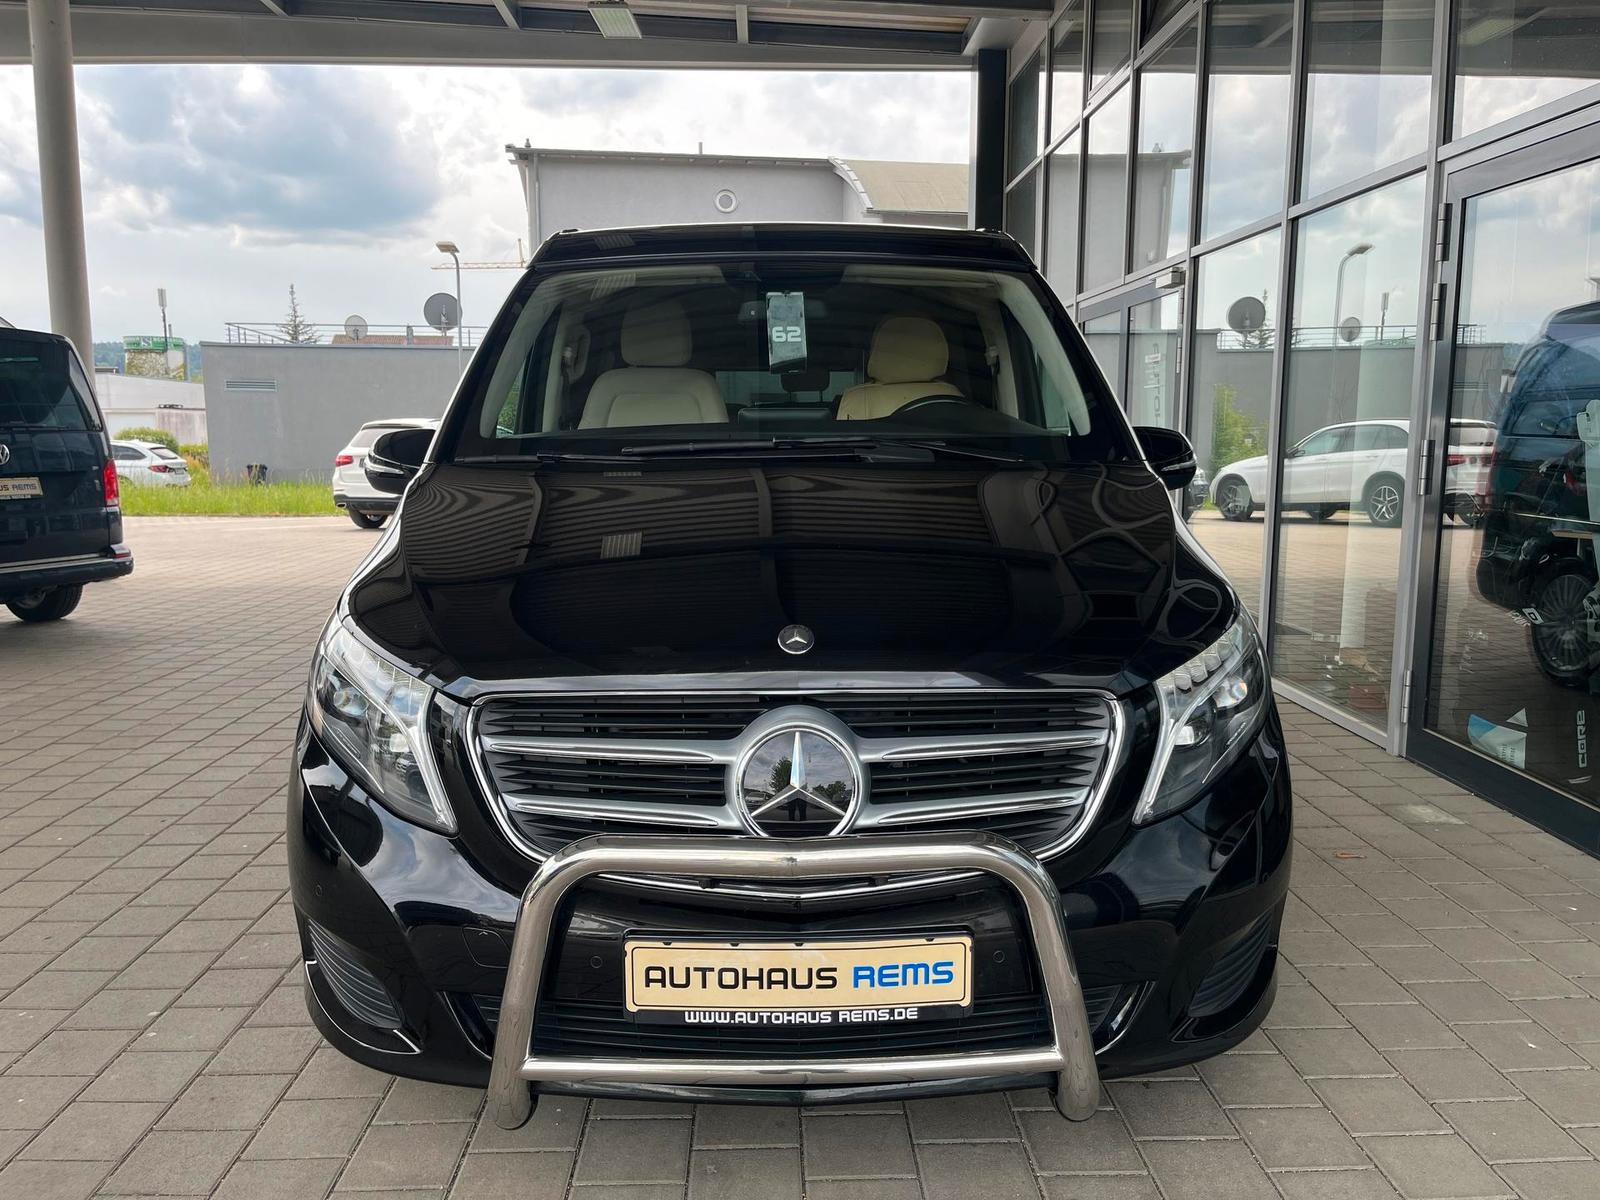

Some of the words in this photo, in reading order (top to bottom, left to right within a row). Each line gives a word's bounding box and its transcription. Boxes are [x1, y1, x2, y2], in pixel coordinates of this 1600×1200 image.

[772, 326, 802, 343] 62
[644, 966, 838, 990] AUTOHAUS
[852, 961, 954, 989] REMS
[684, 1010, 832, 1025] WWW.AUTOHAUS
[838, 1007, 918, 1023] REMS.DE
